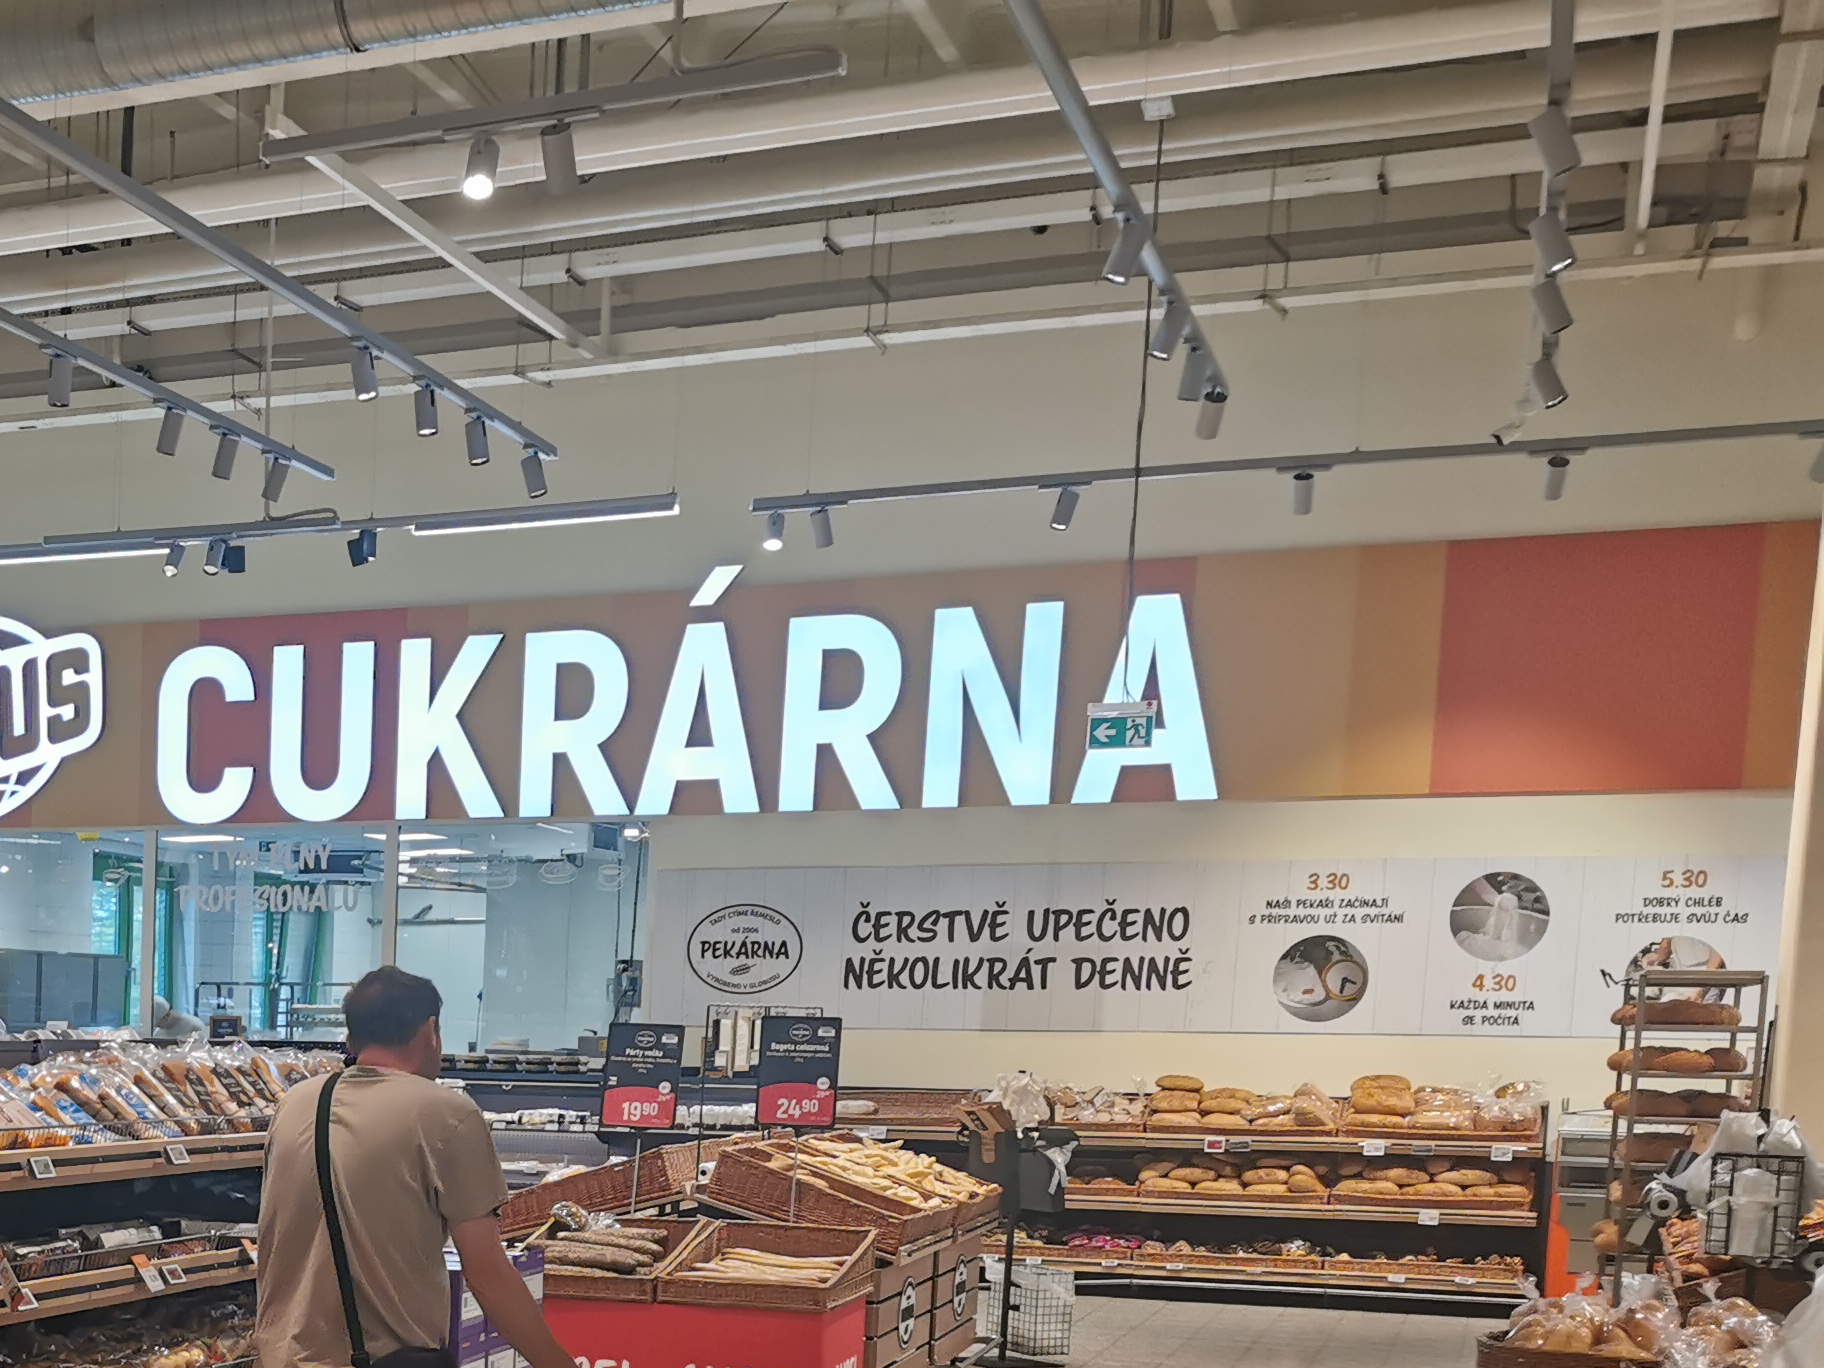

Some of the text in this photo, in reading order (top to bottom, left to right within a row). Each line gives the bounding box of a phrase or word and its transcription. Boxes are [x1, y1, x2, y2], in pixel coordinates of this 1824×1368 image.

[157, 565, 1218, 824] CUKRÁRNA
[1306, 873, 1351, 891] 3.30
[1660, 869, 1709, 889] 5.30
[1266, 897, 1291, 910] NAŠI
[1338, 896, 1389, 910] ZAČÍNAJÍ
[1642, 894, 1723, 908] DOBRÝ CHLÉB
[709, 913, 727, 926] TADY
[851, 898, 1191, 943] ČERSTVĚ UPEČENO
[1248, 910, 1407, 925] S PŘÍPRAVOU UŽ ZA SVÍTÁNÍ
[1615, 910, 1749, 924] POTŘEBUJE SVŮJ ČAS
[700, 935, 790, 960] PEKÁRNA
[843, 947, 1194, 991] NĚKOLIKRÁT DENNĚ
[1471, 974, 1517, 992] 4.30
[1449, 999, 1536, 1012] KAŽDÁ MINUTA
[1461, 1013, 1520, 1027] SE POČÍTÁ
